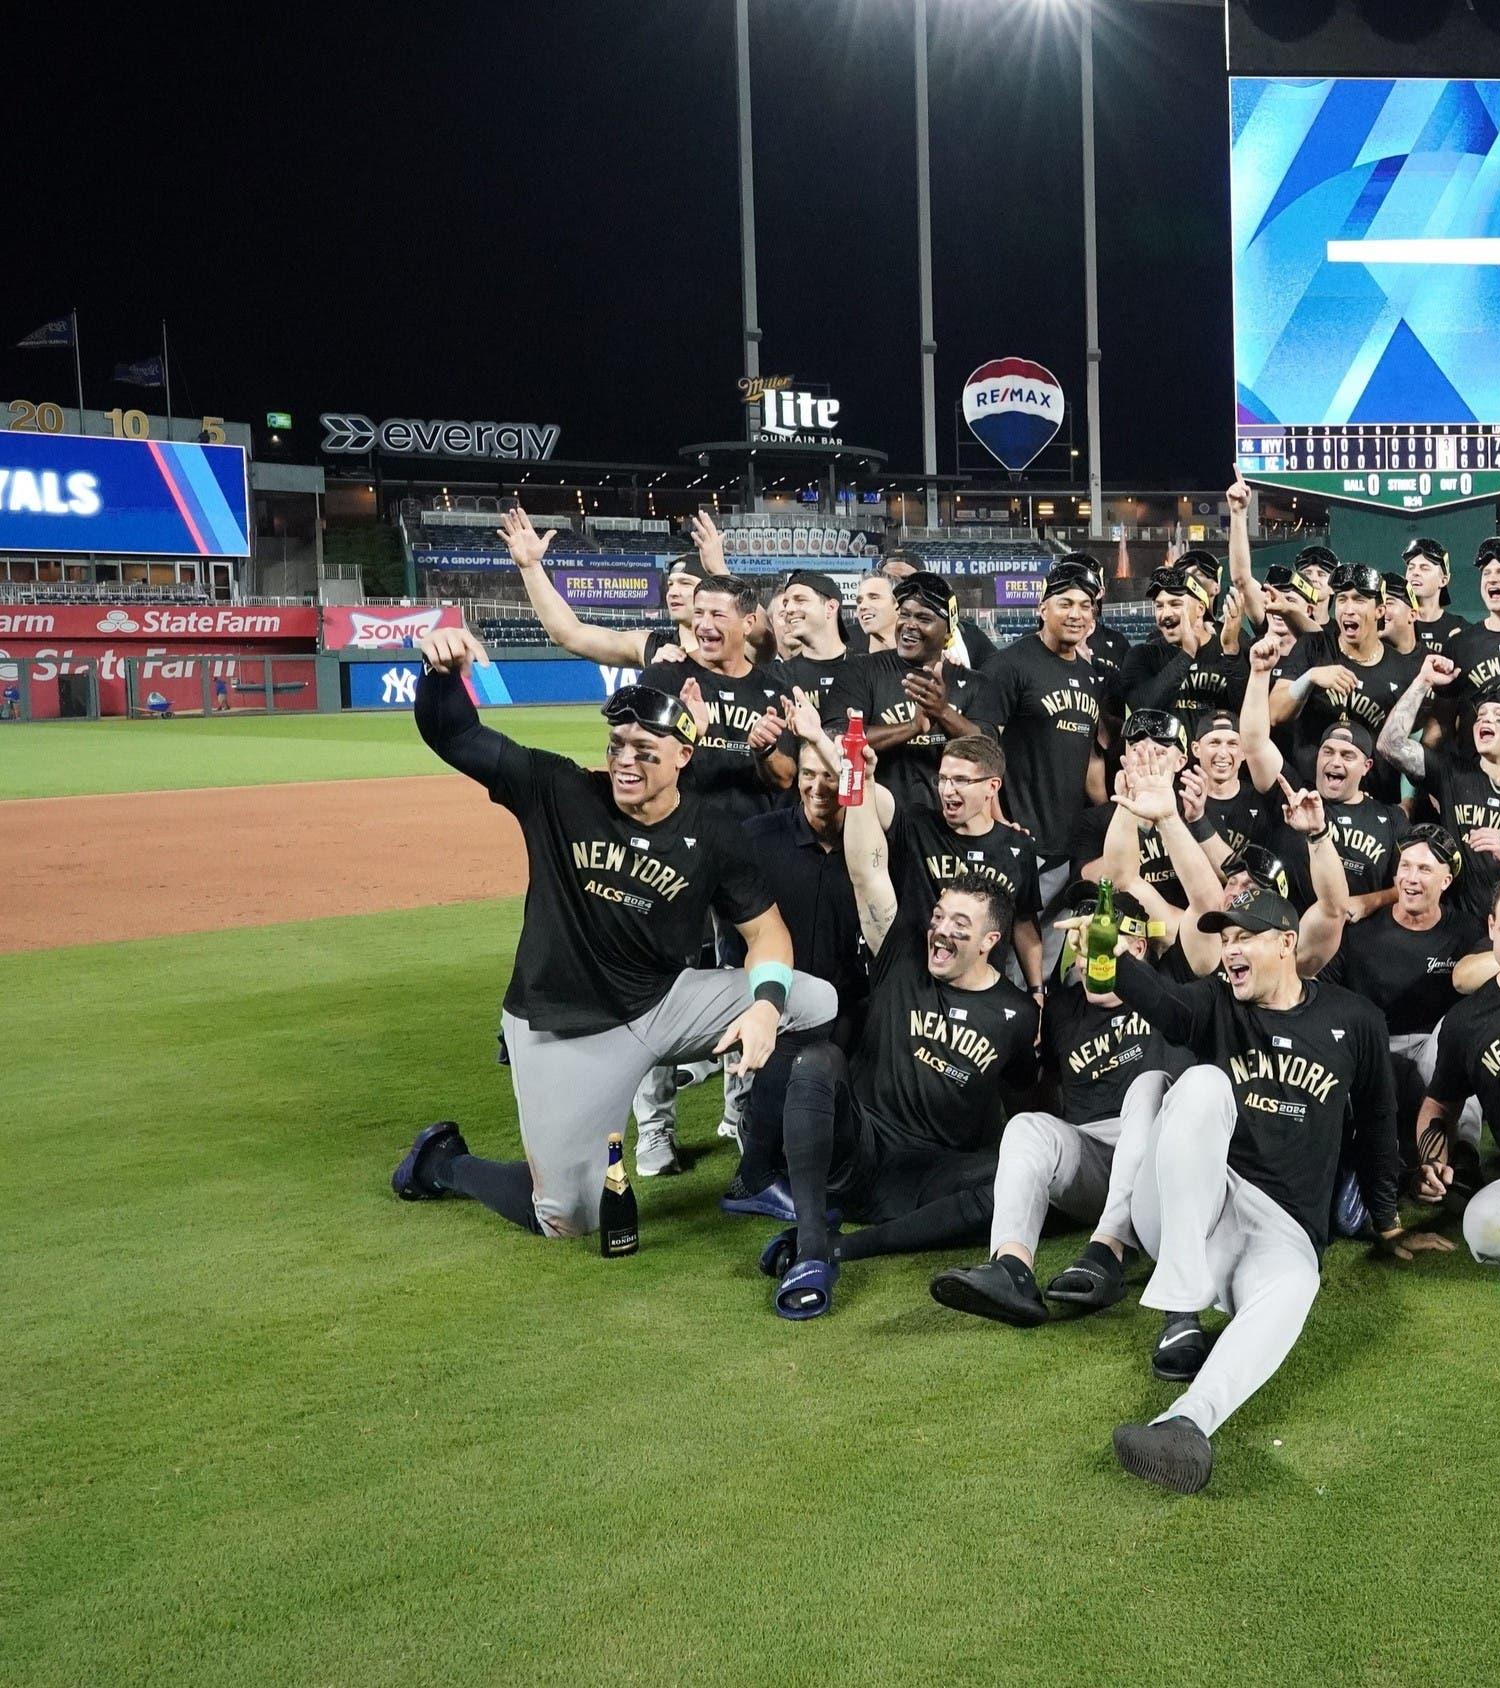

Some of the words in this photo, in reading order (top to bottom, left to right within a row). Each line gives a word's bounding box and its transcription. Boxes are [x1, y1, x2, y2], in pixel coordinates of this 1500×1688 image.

[976, 387, 1051, 409] RE/MAX
[9, 400, 64, 433] 20
[761, 388, 840, 437] Lite
[105, 408, 150, 440] 10
[202, 416, 227, 443] 5
[383, 422, 556, 460] evergy
[753, 433, 816, 445] FOUNTAIN
[821, 437, 843, 446] BAR
[1261, 439, 1283, 453] NYY
[1291, 439, 1296, 453] 1
[1306, 439, 1314, 453] 0
[1323, 439, 1331, 453] 0
[1341, 439, 1348, 453] 0
[1358, 439, 1364, 453] 1
[1375, 439, 1380, 453] 1
[1391, 439, 1399, 453] 0
[1408, 438, 1416, 452] 0
[1424, 438, 1432, 452] 0
[1460, 438, 1468, 452] 8
[1477, 438, 1485, 452] 0
[1290, 455, 1298, 469] 0
[1307, 455, 1314, 469] 0
[1324, 455, 1331, 469] 0
[1341, 455, 1348, 469] 0
[1357, 455, 1365, 469] 0
[1375, 455, 1381, 469] 1
[1391, 455, 1399, 469] 0
[1409, 454, 1416, 468] 0
[1425, 454, 1432, 468] 0
[1460, 454, 1468, 468] 6
[1477, 454, 1485, 468] 0
[0, 470, 101, 514] ALS
[1343, 480, 1365, 491] BALL
[1368, 474, 1379, 495] 0
[1387, 479, 1416, 491] STRIKE
[1420, 473, 1431, 495] 0
[1439, 479, 1458, 491] OUT
[1460, 473, 1472, 495] 0
[417, 557, 440, 565] GOT
[441, 557, 449, 565] A
[451, 557, 490, 566] GROUP?
[493, 558, 516, 566] BRIN
[740, 557, 772, 566] 4-PACK
[955, 560, 966, 574] &
[566, 578, 594, 589] FREE
[598, 578, 648, 590] TRAINING
[567, 590, 587, 598] WITH
[587, 590, 602, 599] GYM
[604, 590, 648, 599] MEMBERSHIP
[1005, 581, 1028, 590] FREE
[1005, 591, 1020, 599] WITH
[1021, 591, 1034, 599] GYM
[358, 624, 430, 641] SONIC
[382, 667, 418, 703] NY
[1041, 690, 1071, 716] NEW
[1074, 690, 1099, 723] YORK
[1349, 690, 1386, 728] YORK
[1056, 718, 1077, 731] ALCS
[698, 736, 727, 748] ALCS
[726, 741, 750, 750] 2024
[1454, 804, 1486, 827] NEW
[1342, 827, 1386, 865] YORK
[572, 841, 627, 872] NEW
[630, 853, 689, 901] YORK
[1144, 870, 1169, 882] ALCS
[1343, 860, 1365, 870] 2024
[584, 880, 624, 903] ALCS
[623, 894, 653, 909] 2024
[909, 1009, 948, 1043] NEW
[949, 1023, 998, 1075] YORK
[913, 1046, 946, 1073] ALCS
[945, 1066, 969, 1082] 2024
[1069, 1033, 1110, 1074] NEW
[1118, 1046, 1142, 1062] 2024
[1230, 1049, 1274, 1085] NEW
[1277, 1053, 1339, 1104] YORK
[1244, 1092, 1279, 1113] ALCS
[1278, 1103, 1306, 1115] 2024
